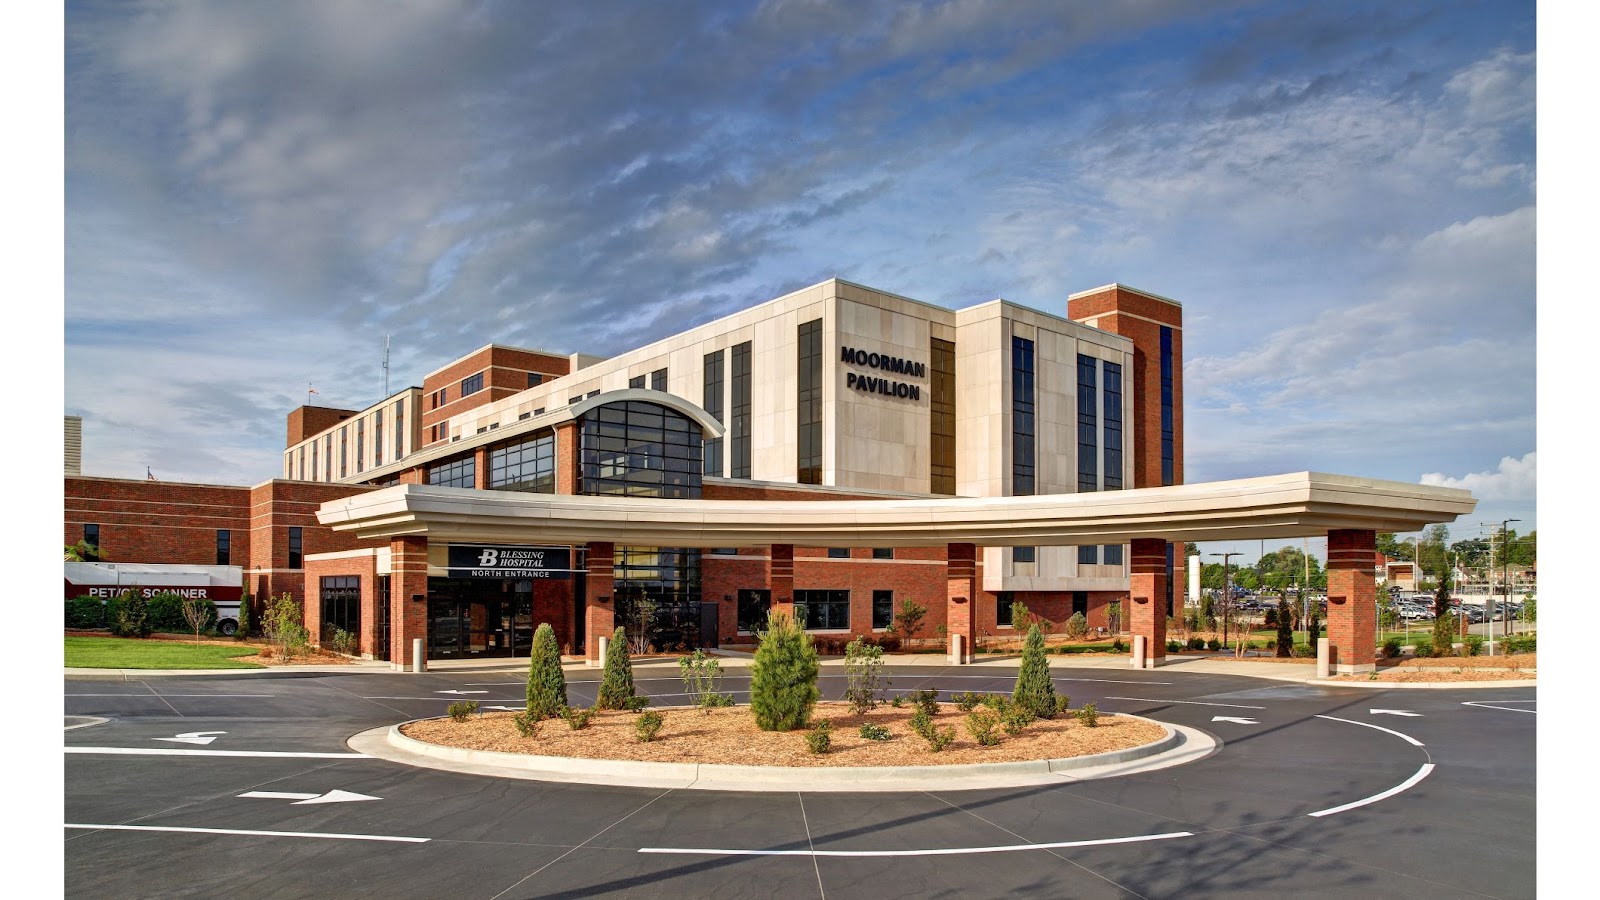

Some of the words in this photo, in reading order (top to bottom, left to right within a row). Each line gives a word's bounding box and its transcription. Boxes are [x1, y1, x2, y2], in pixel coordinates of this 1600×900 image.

[840, 346, 925, 378] MOORMAN
[846, 372, 920, 401] PAVILION
[478, 549, 498, 566] B
[500, 551, 544, 559] BLESSING
[499, 559, 544, 567] HOSPITAL
[505, 570, 550, 578] ENTRANCE
[89, 587, 139, 598] PET/C
[142, 588, 207, 599] SCANNER
